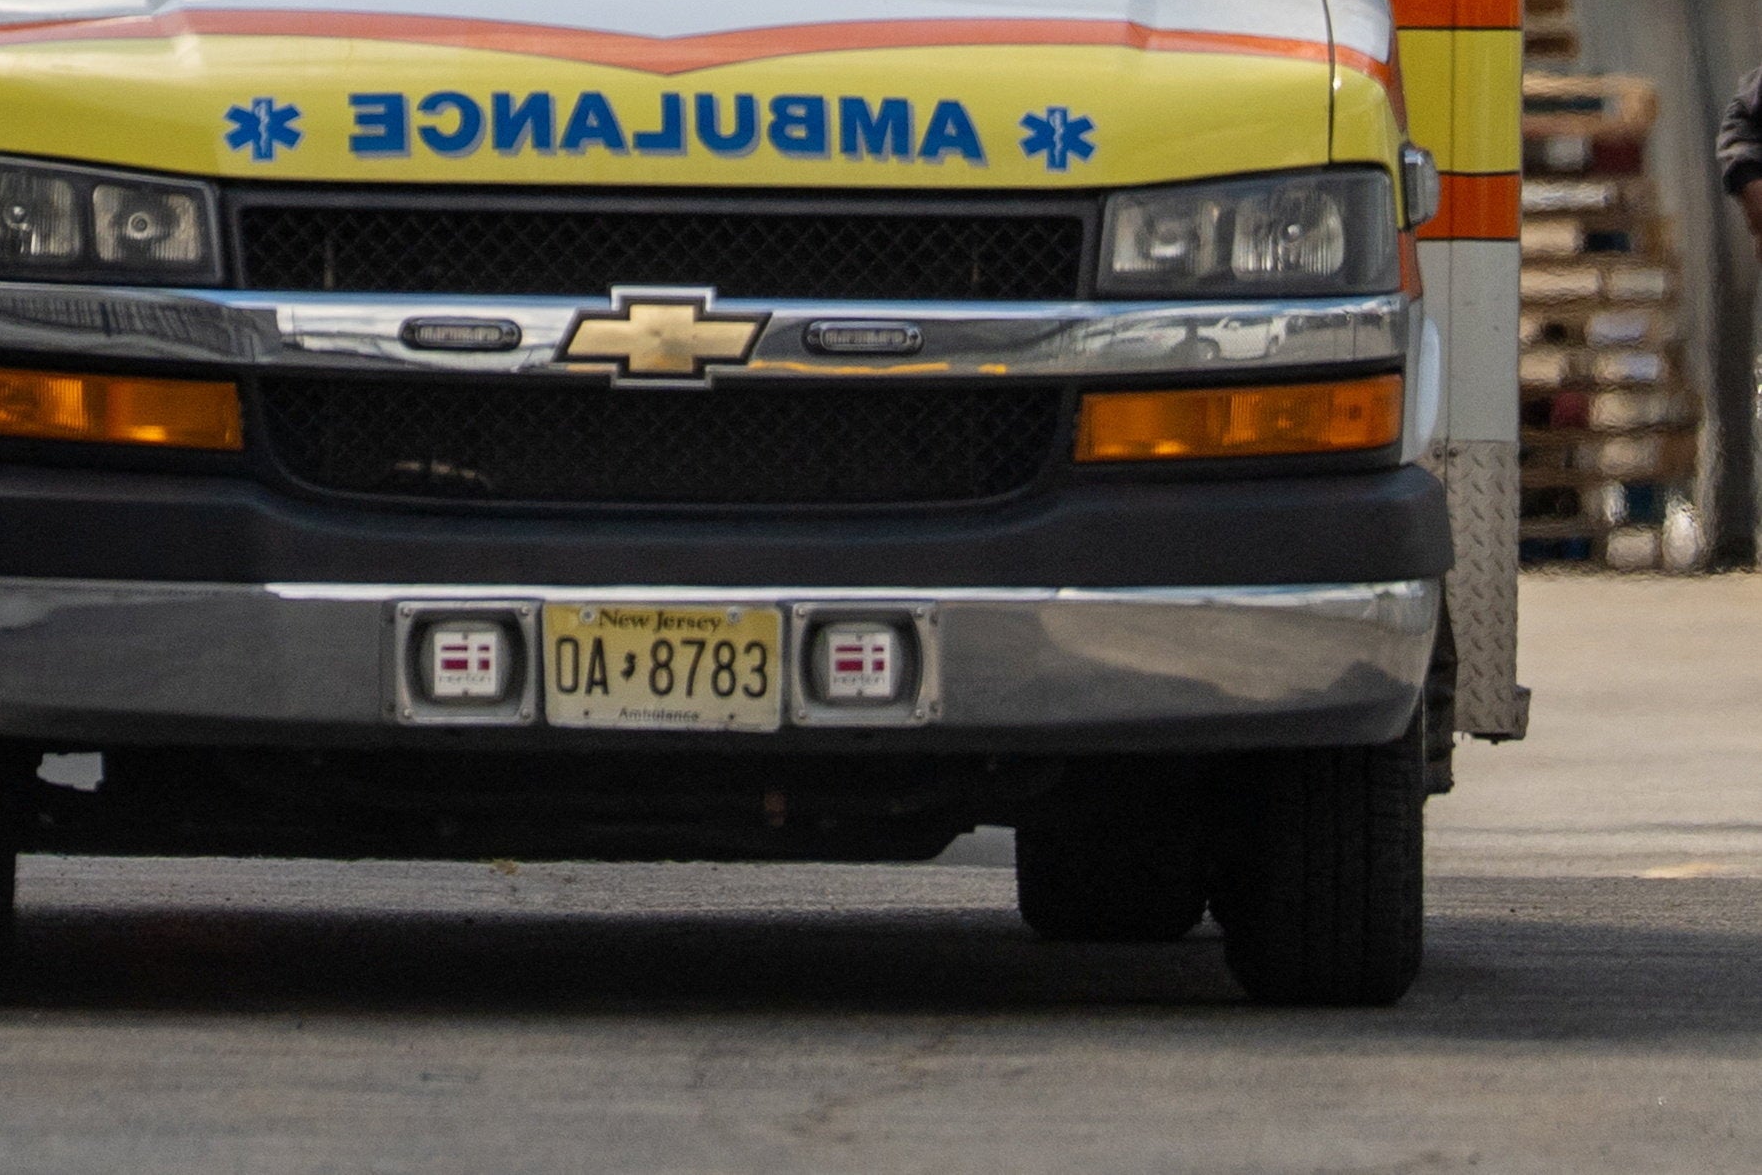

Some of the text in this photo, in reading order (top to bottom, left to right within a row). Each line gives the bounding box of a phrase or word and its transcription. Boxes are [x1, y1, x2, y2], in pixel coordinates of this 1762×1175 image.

[599, 610, 722, 632] New Jersey
[649, 639, 767, 698] 8783
[619, 707, 700, 722] Ambulance
